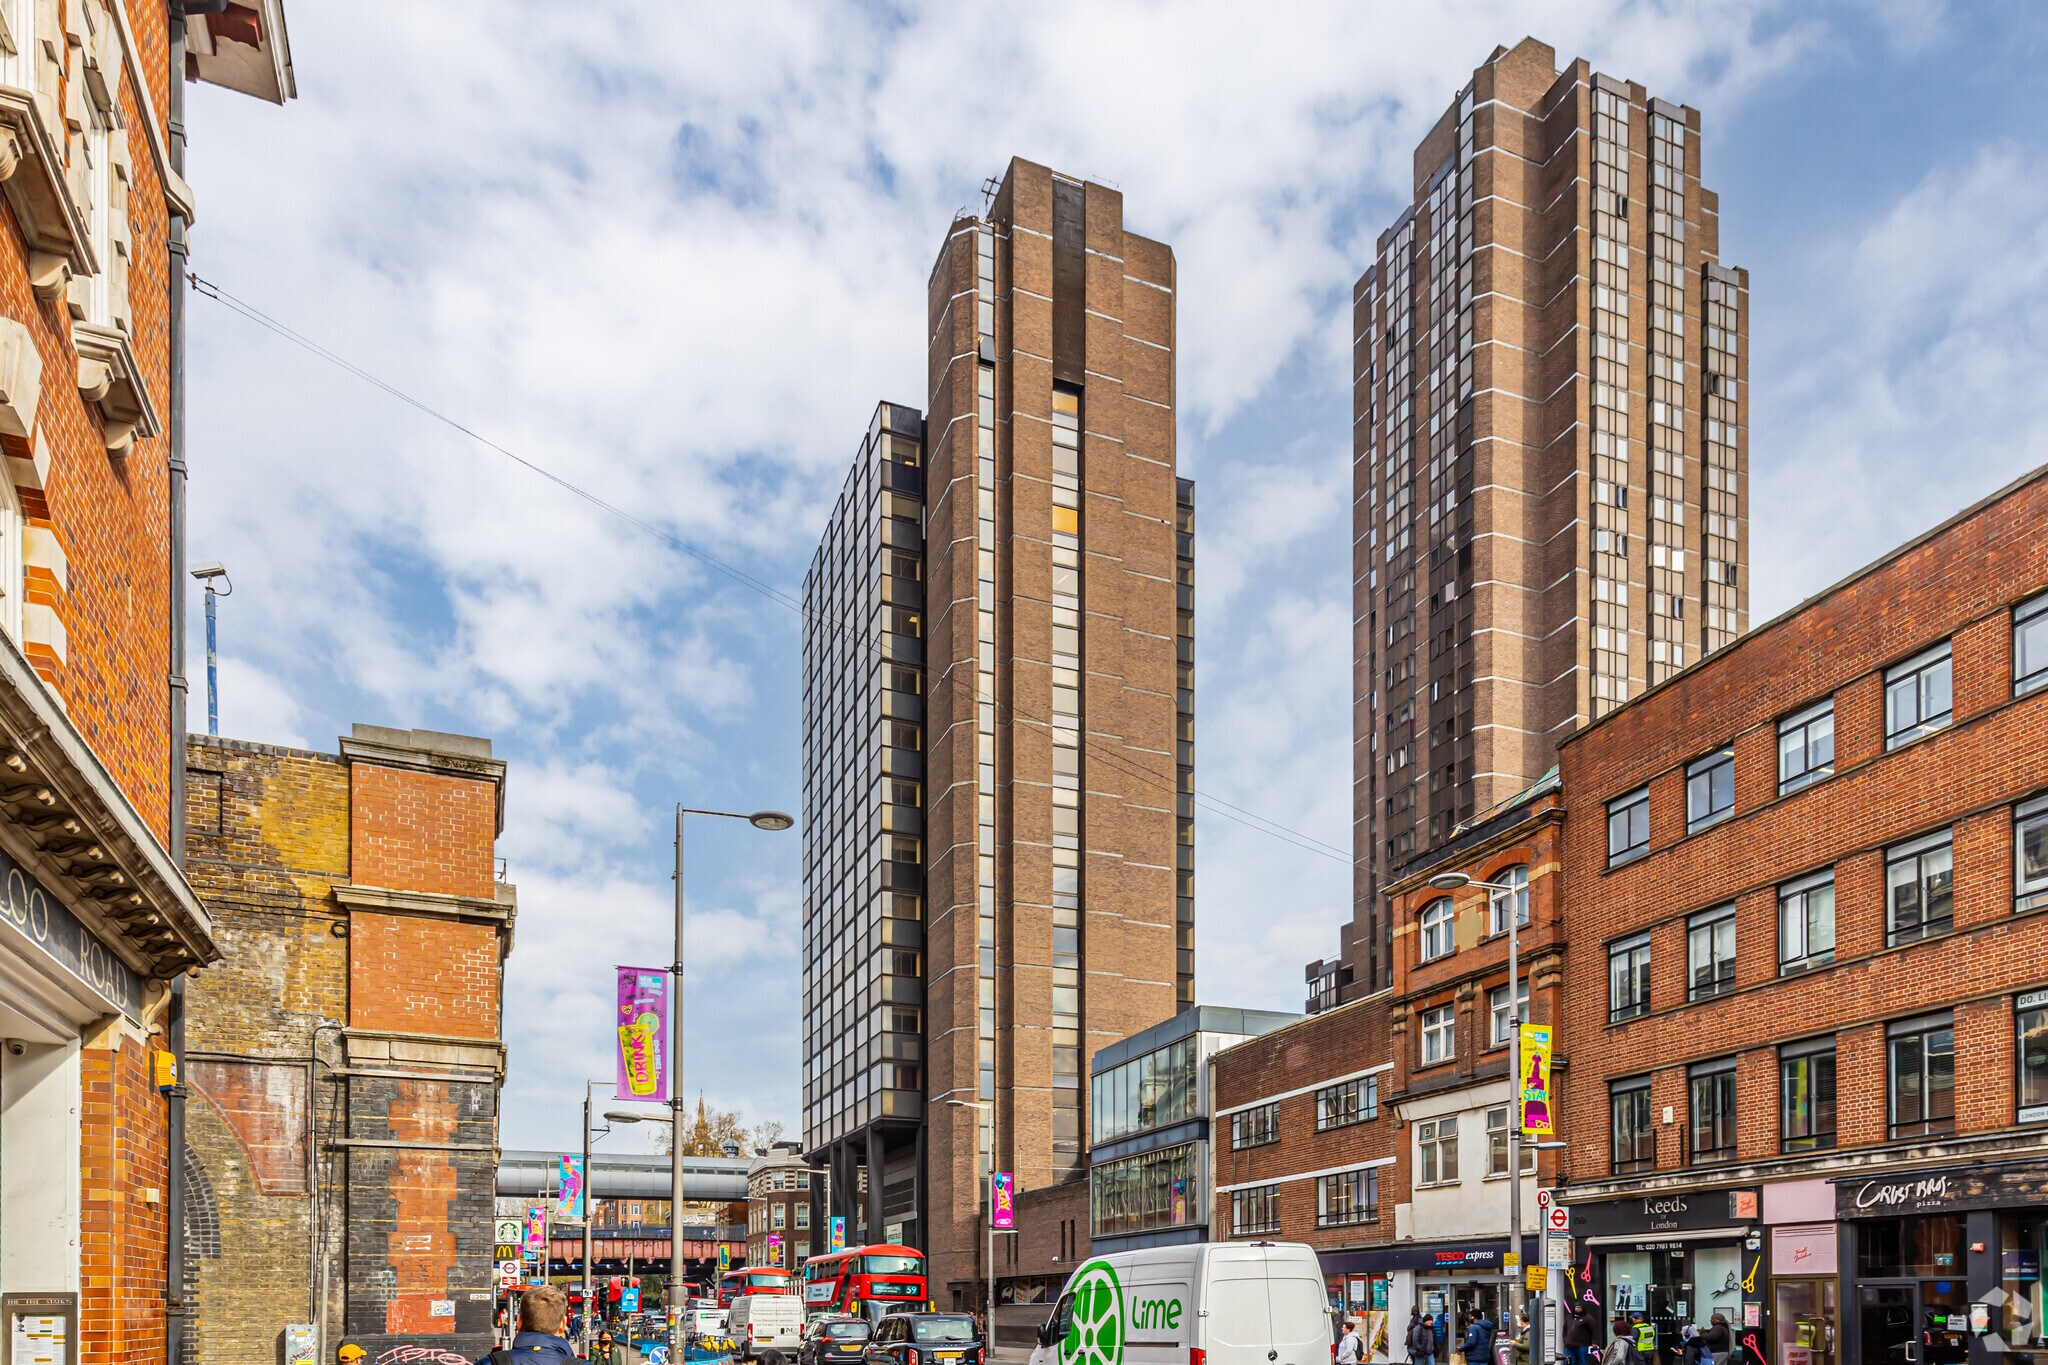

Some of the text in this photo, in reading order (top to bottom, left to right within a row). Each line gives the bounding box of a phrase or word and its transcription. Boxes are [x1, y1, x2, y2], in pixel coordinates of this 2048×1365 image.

[80, 928, 128, 1009] ROAD
[2020, 992, 2048, 1005] DO. LI
[631, 1034, 648, 1082] DRINK
[1523, 1088, 1547, 1102] STAY
[2021, 1111, 2045, 1119] LONDON
[1541, 1193, 1548, 1204] D
[1856, 1180, 1914, 1208] CRUST
[1643, 1196, 1688, 1215] Reeds
[1916, 1200, 1941, 1208] pizza
[1651, 1221, 1678, 1230] London
[1434, 1251, 1494, 1261] TESCO express
[905, 1285, 917, 1294] 59
